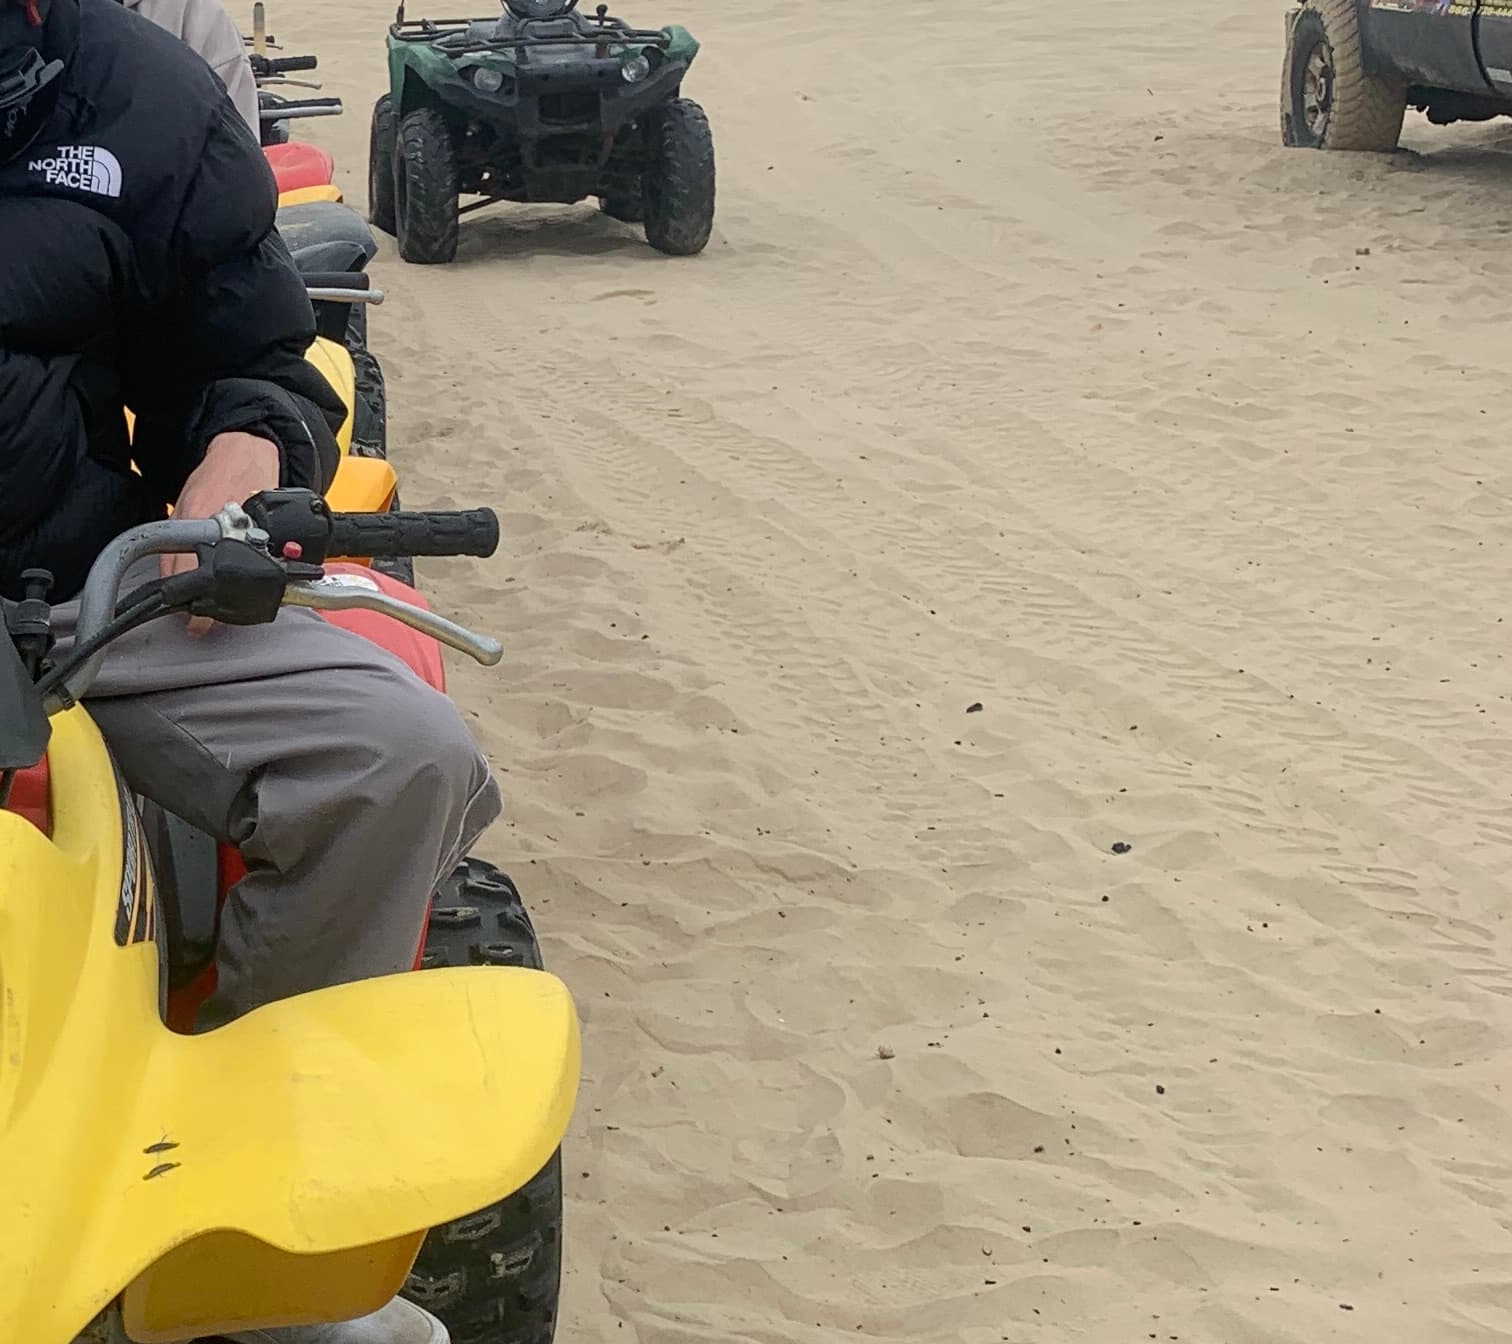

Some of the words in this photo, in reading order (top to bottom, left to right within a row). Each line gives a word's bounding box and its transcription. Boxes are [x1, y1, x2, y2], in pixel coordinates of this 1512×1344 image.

[57, 146, 93, 161] THE
[28, 158, 93, 175] NORTH
[46, 170, 91, 191] FACE
